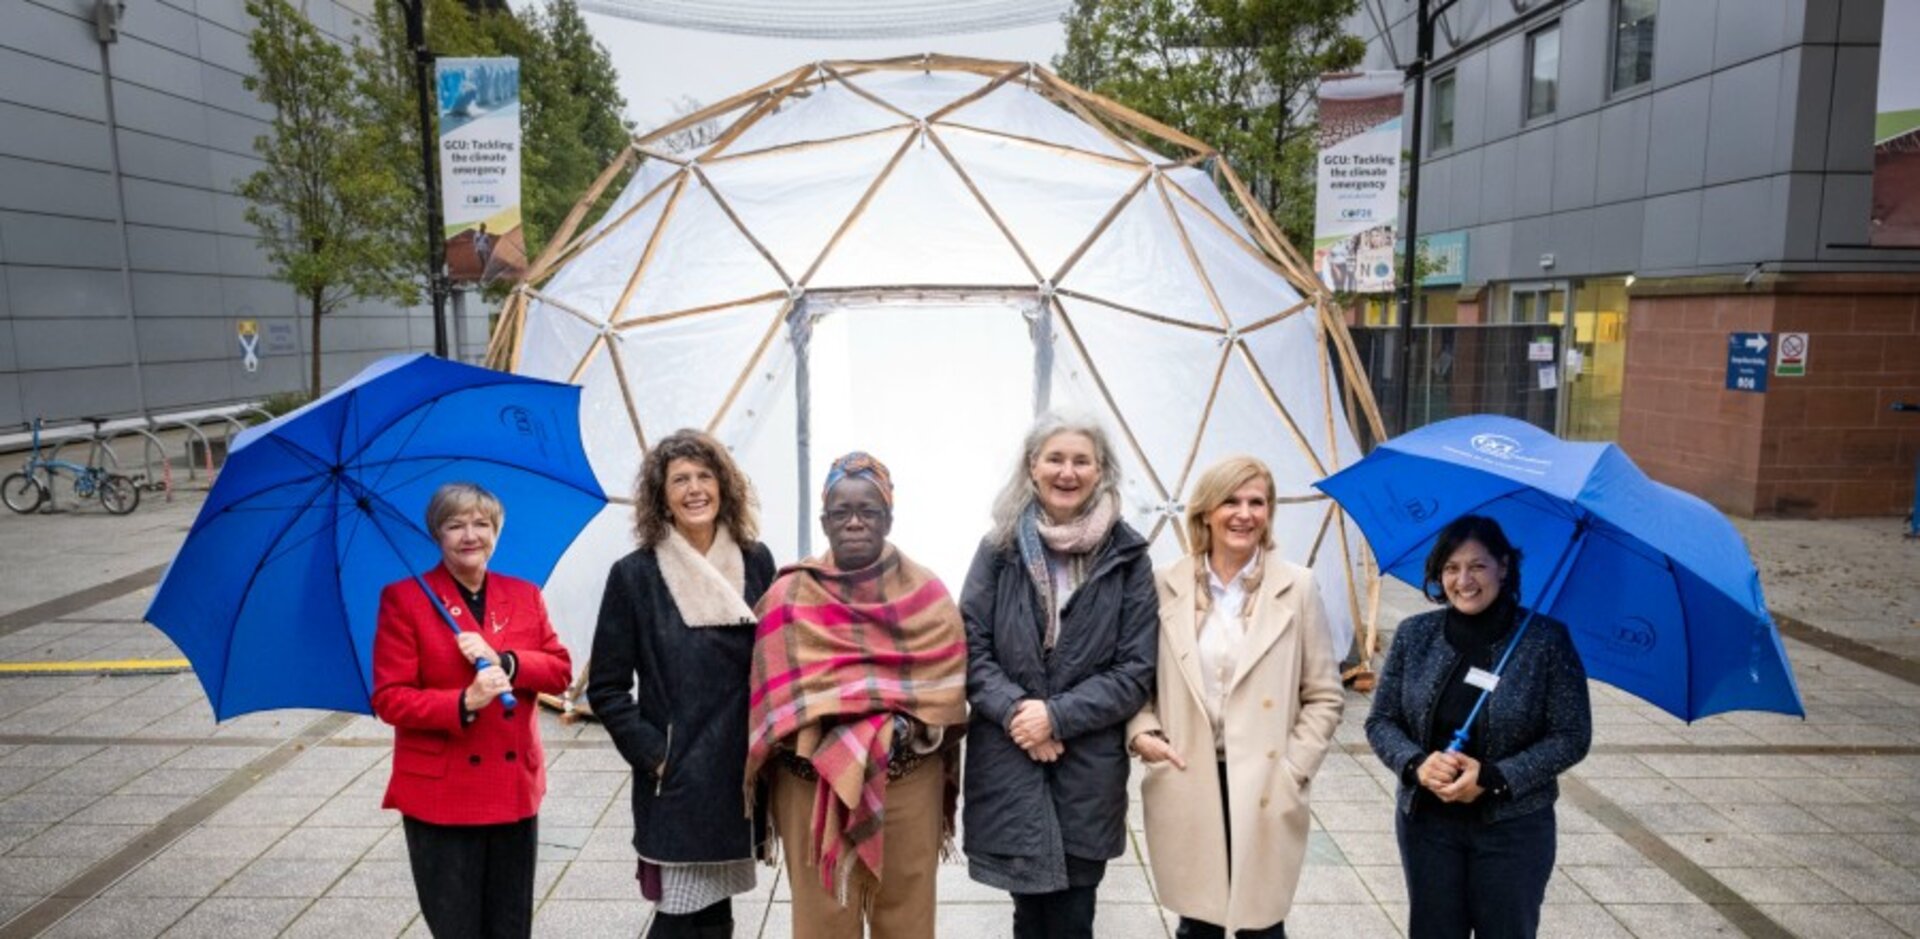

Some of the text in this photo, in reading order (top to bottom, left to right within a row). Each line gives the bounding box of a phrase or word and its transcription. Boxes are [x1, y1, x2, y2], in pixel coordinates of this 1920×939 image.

[444, 140, 514, 151] GCU: Tackling
[451, 152, 507, 162] the climate
[1324, 154, 1395, 166] GCU: Tackling
[452, 166, 506, 176] emergency
[1330, 167, 1388, 177] the climate
[1330, 181, 1386, 191] emergency
